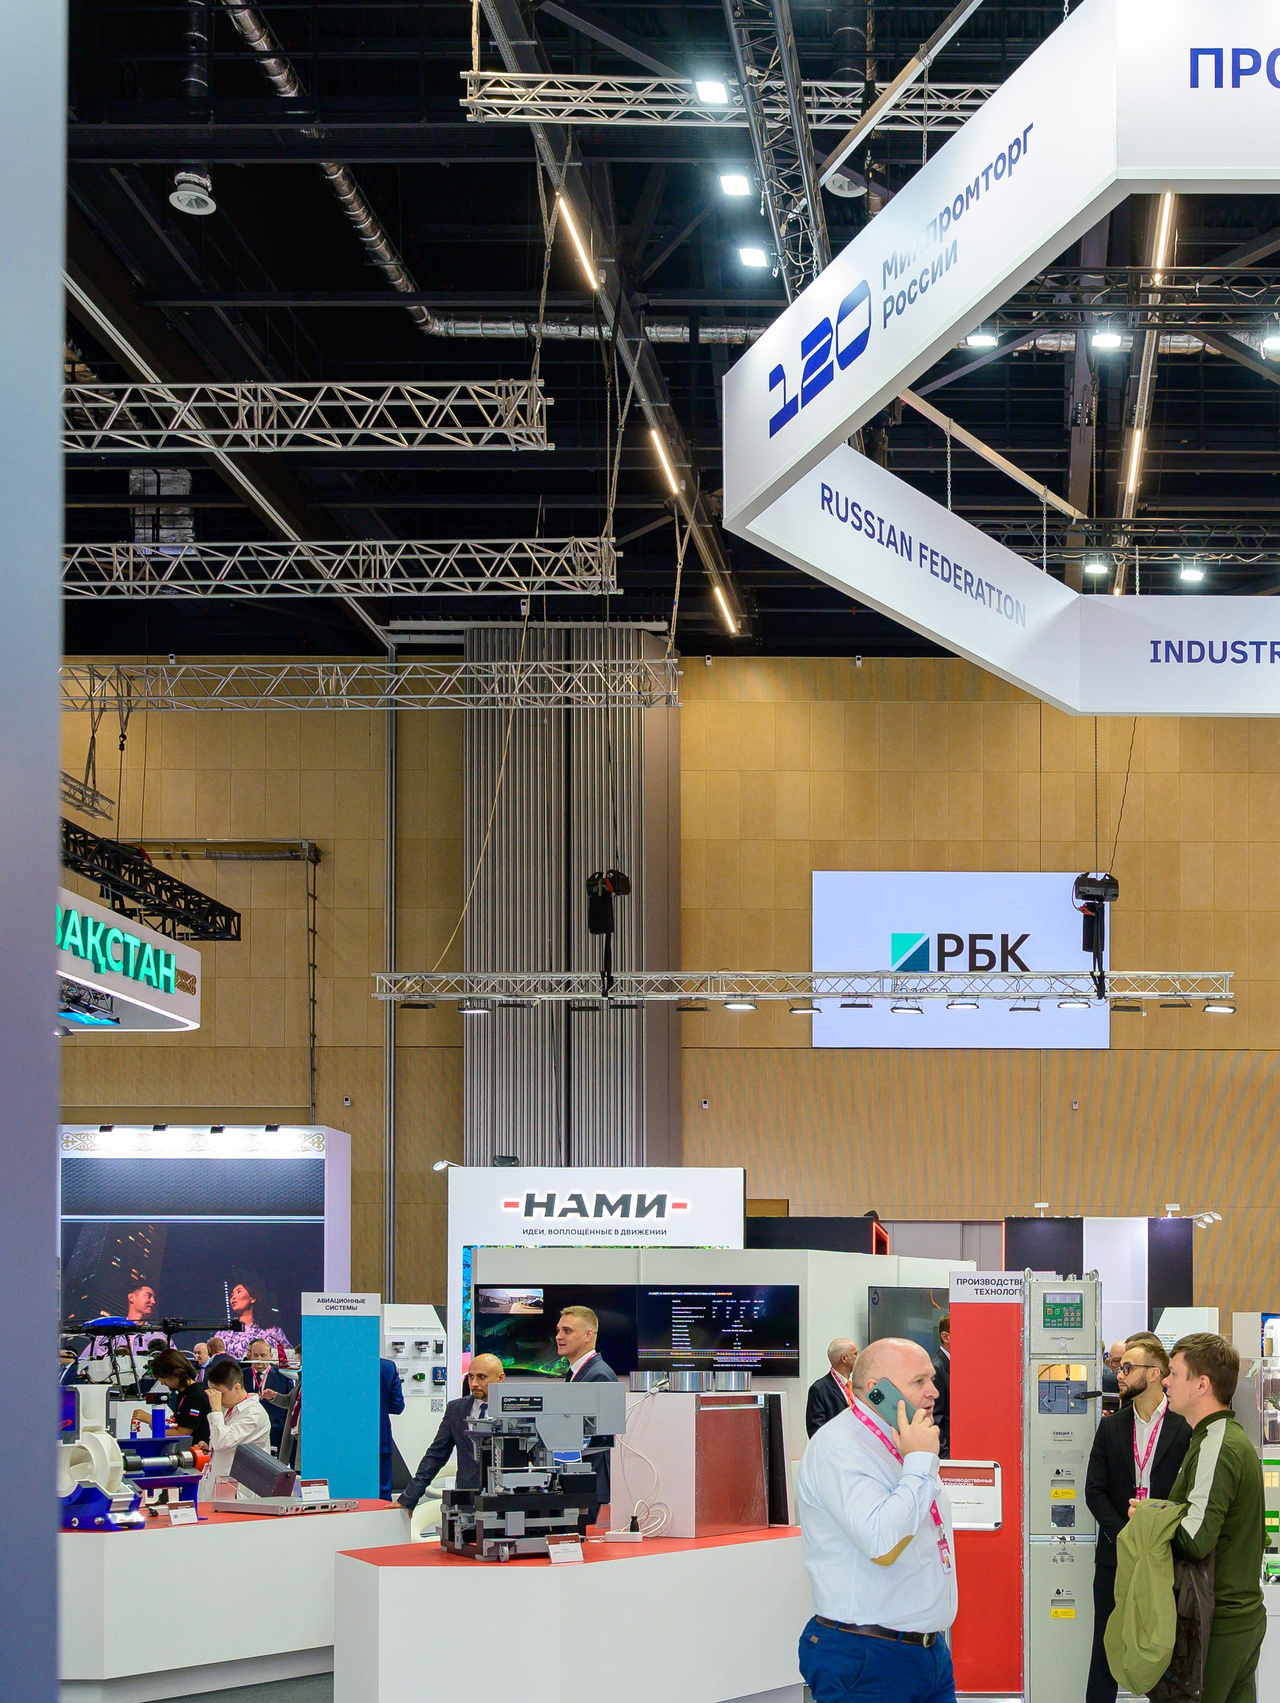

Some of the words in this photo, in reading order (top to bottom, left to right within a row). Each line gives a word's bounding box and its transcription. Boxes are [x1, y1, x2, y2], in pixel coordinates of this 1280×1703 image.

[882, 122, 1034, 291] Минпромторг
[883, 239, 958, 330] России
[768, 279, 872, 439] 120
[820, 482, 913, 562] RUSSIAN
[919, 541, 1026, 628] FEDERATION
[937, 933, 1031, 972] РБК
[522, 1228, 547, 1236] ИДЕИ,
[548, 1227, 613, 1236] ВОПЛОЩЁННЫЕ
[620, 1228, 667, 1236] ДВИЖЕНИИ
[523, 1193, 667, 1218] НАМИ
